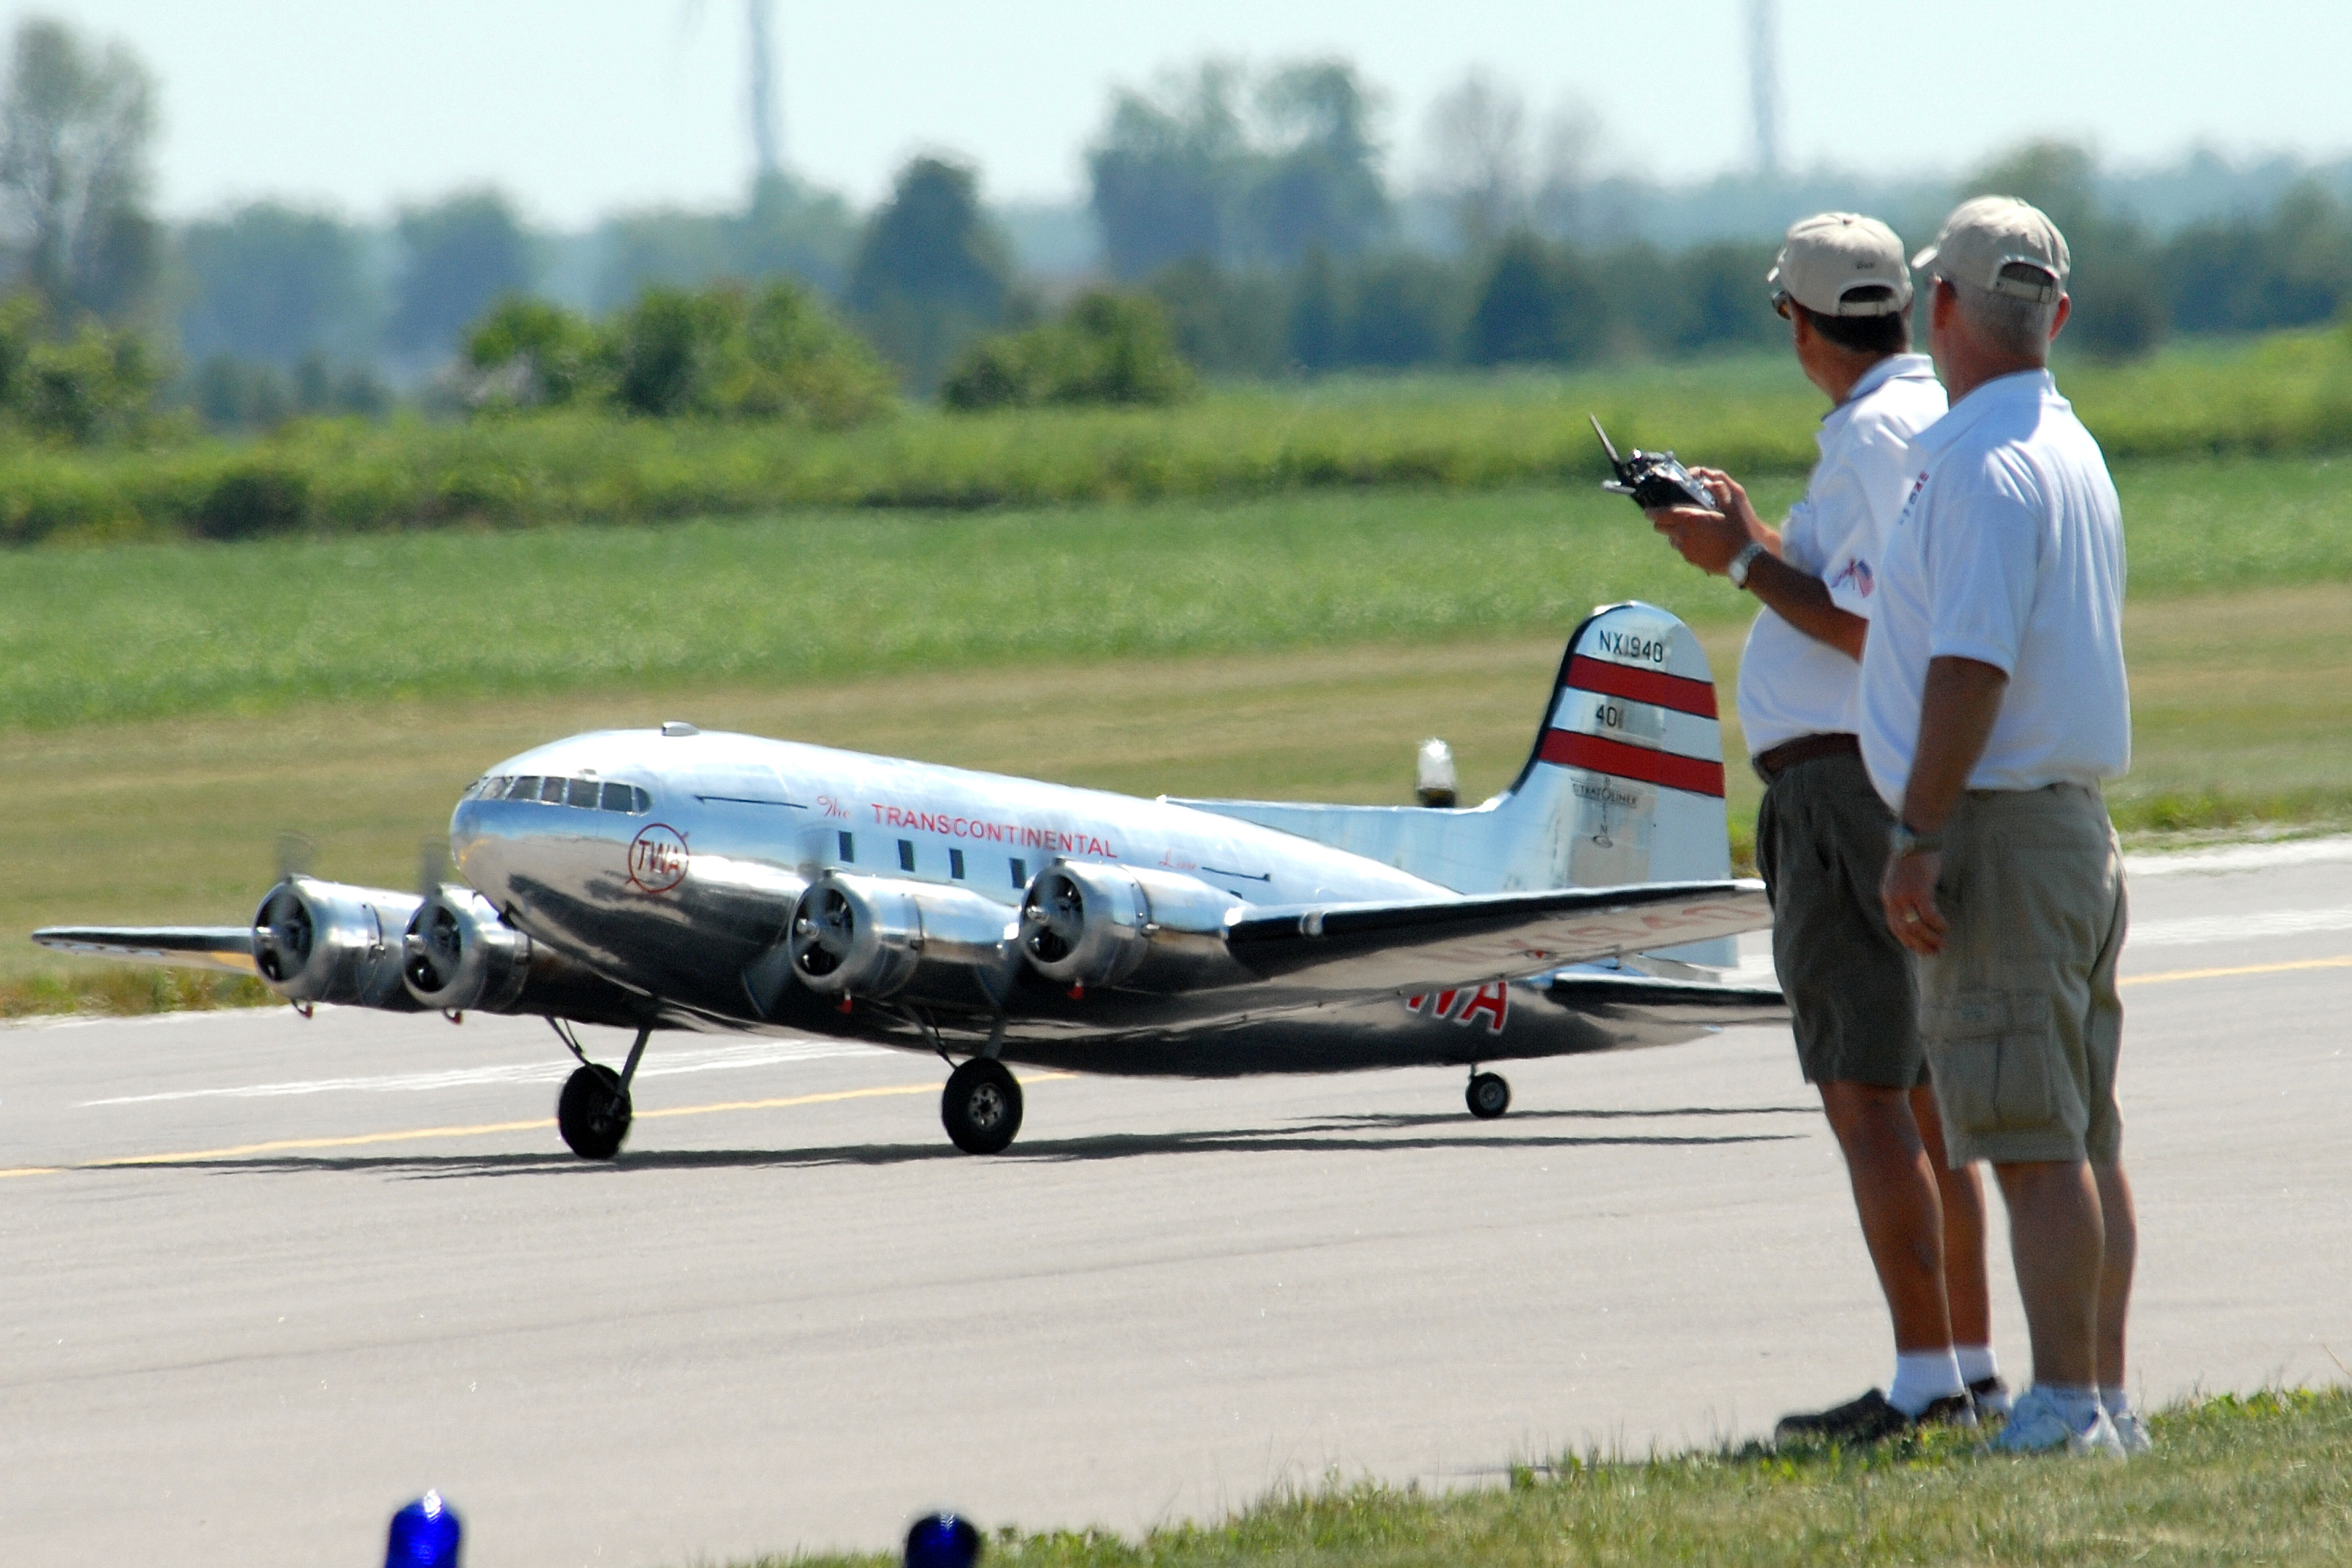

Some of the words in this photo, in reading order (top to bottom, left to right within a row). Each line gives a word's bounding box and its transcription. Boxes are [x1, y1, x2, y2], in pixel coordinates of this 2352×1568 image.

[1600, 630, 1663, 663] NX1940
[1595, 704, 1625, 729] 401
[870, 803, 1118, 859] TRANSCONTINENTAL
[638, 839, 683, 878] TWA
